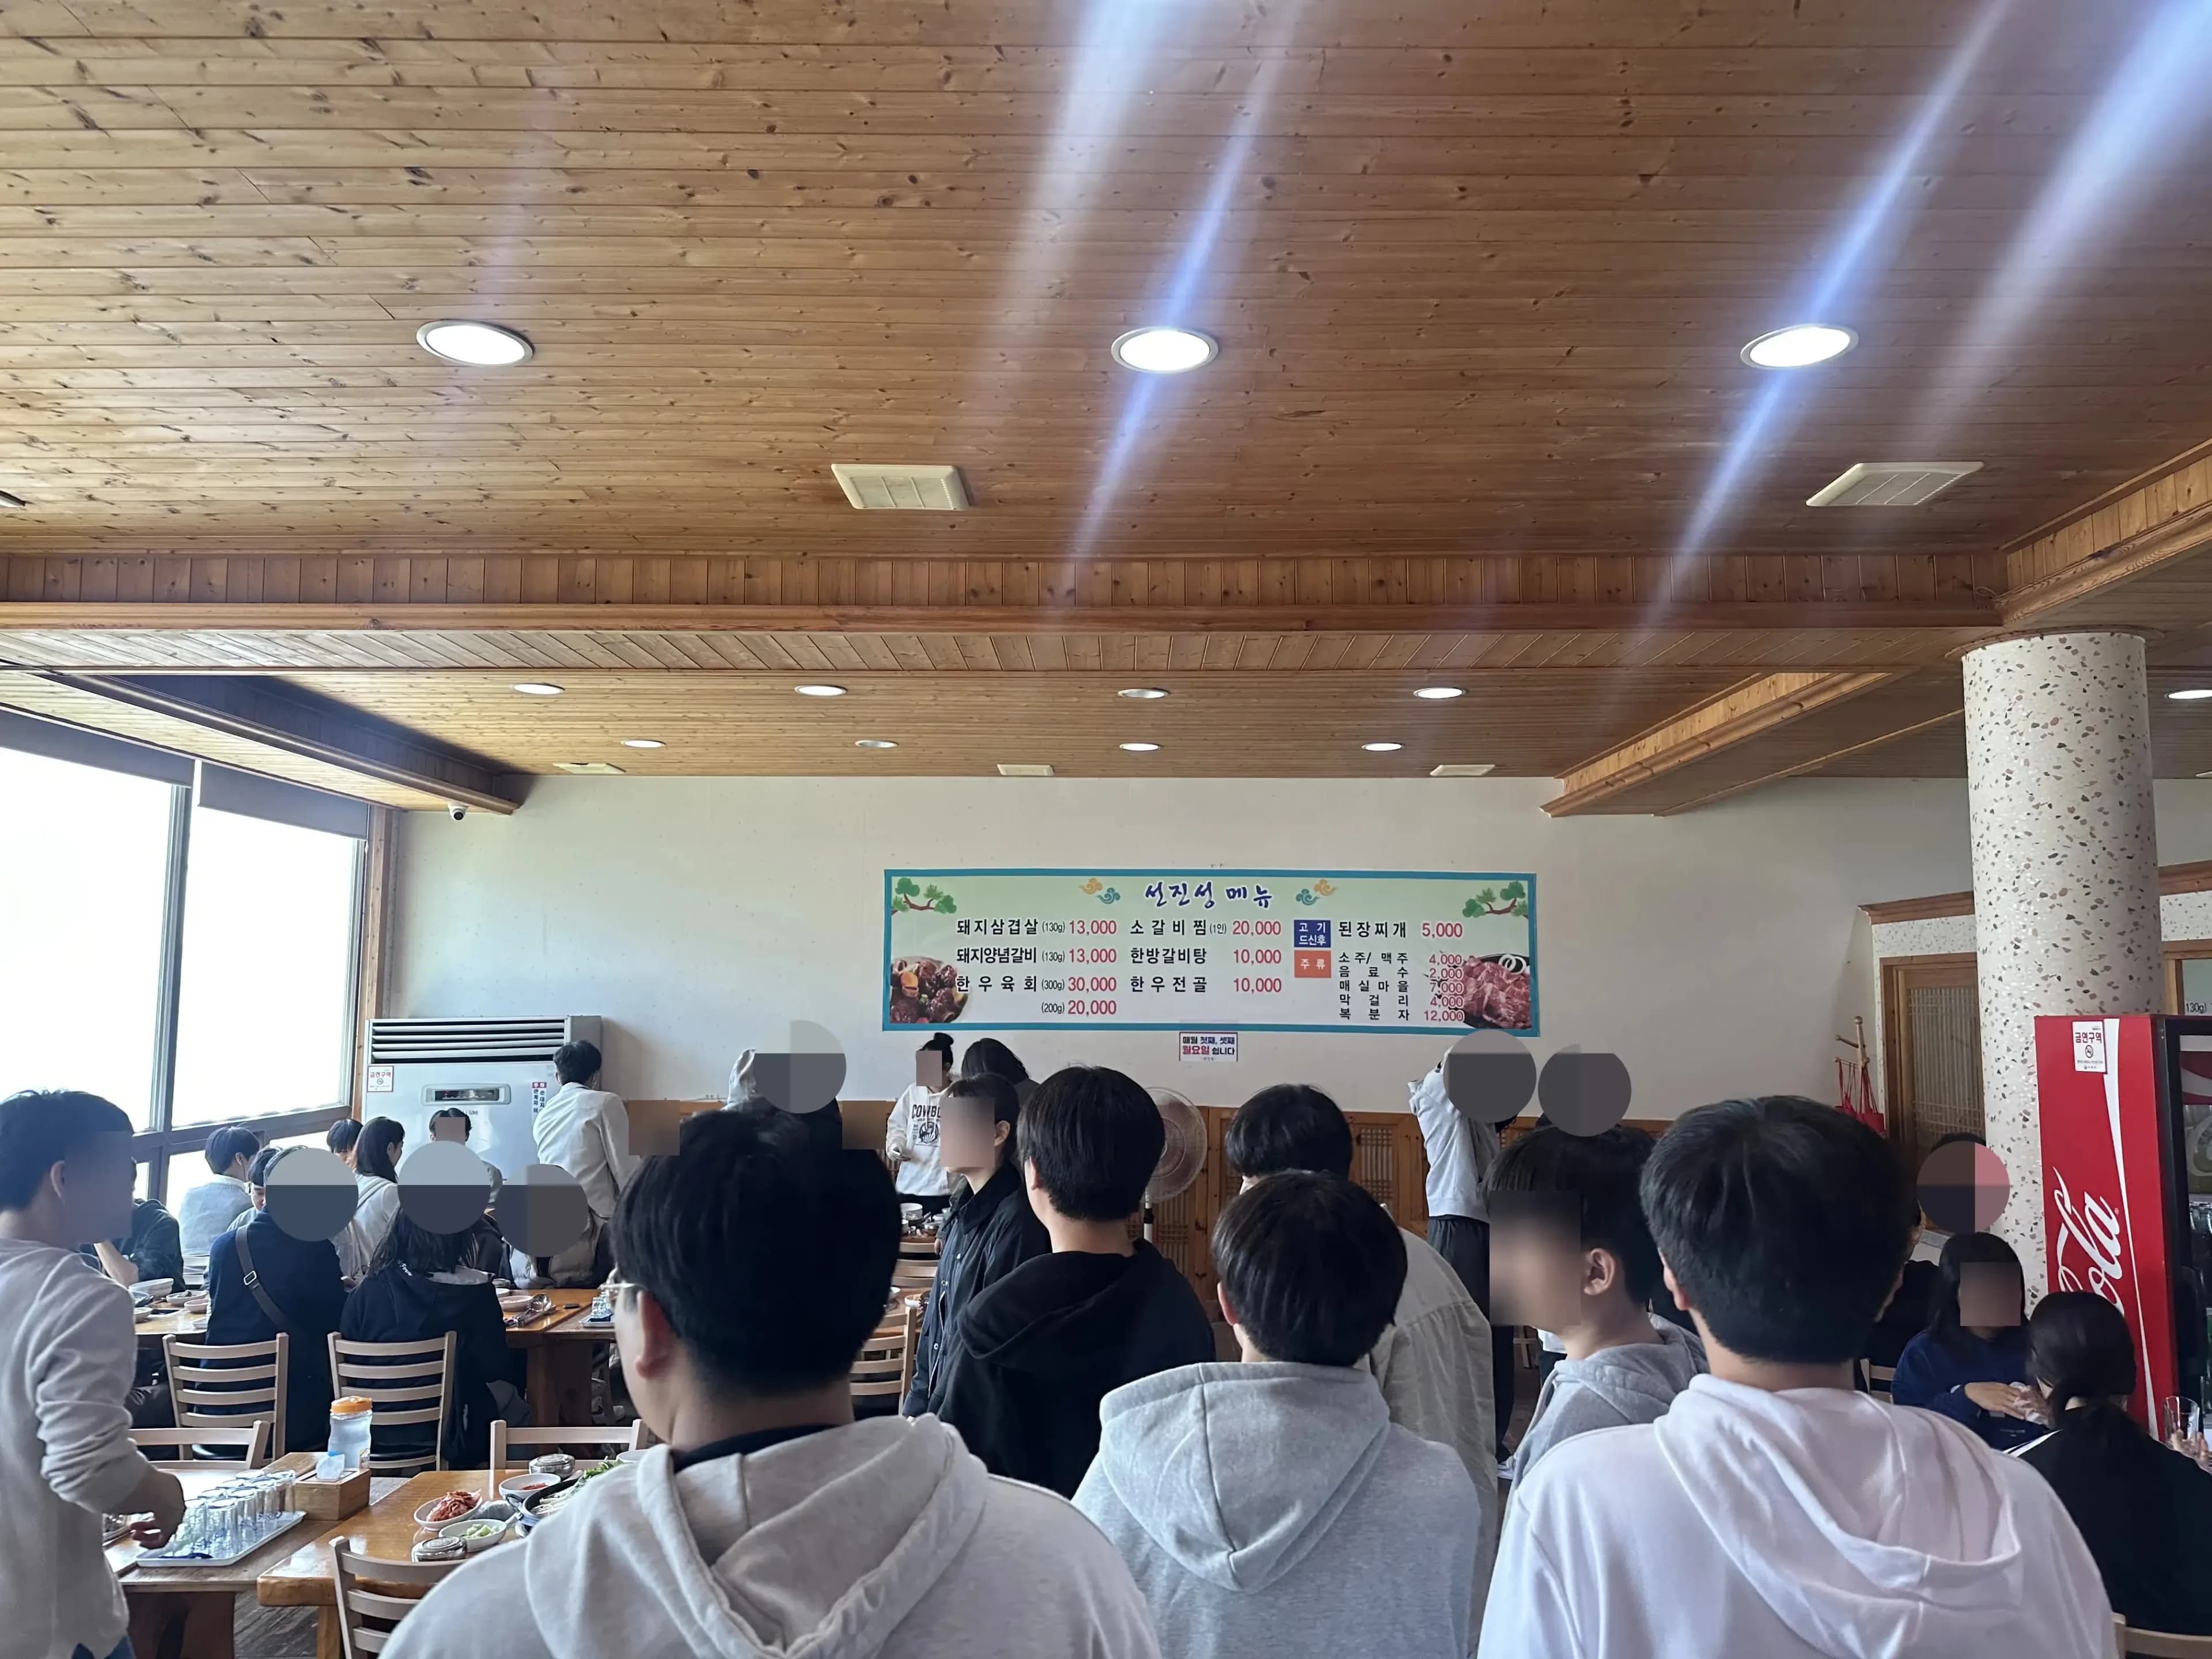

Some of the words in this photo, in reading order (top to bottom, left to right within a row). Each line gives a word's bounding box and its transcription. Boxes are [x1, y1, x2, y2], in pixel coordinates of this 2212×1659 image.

[1145, 881, 1215, 908] 선진성
[1225, 885, 1272, 908] 메뉴
[957, 919, 1037, 935] 돼지삼겹살
[1042, 922, 1065, 933] (130g)
[1069, 920, 1117, 935] 13,000
[1130, 919, 1206, 935] 소갈비찜
[1232, 921, 1281, 936] 20,000
[1299, 922, 1326, 933] 고기
[1339, 921, 1406, 938] 된장찌개
[1422, 923, 1463, 938] 5,000
[1299, 934, 1326, 945] 드신후
[956, 947, 1036, 963] 돼지양념갈비
[1041, 950, 1065, 962] (130g)
[1069, 948, 1117, 964] 13,000
[1130, 948, 1207, 964] 한방갈비탕
[1234, 949, 1282, 965] 10,000
[1429, 954, 1462, 965] 4,000
[1430, 968, 1463, 979] 2,000
[1041, 979, 1065, 991] (300g)
[1068, 977, 1117, 993] 30,000
[1130, 976, 1207, 993] 한우전골
[1234, 978, 1282, 994] 10,000
[1430, 983, 1464, 994] 7,000
[1041, 1002, 1065, 1014] (200g)
[1068, 1000, 1117, 1016] 20,000
[1430, 997, 1464, 1008] 4,000
[1424, 1010, 1464, 1022] 12,000
[1183, 1036, 1198, 1044] 매월
[2075, 1032, 2102, 1044] 금연구역
[1183, 1046, 1210, 1055] 월요일
